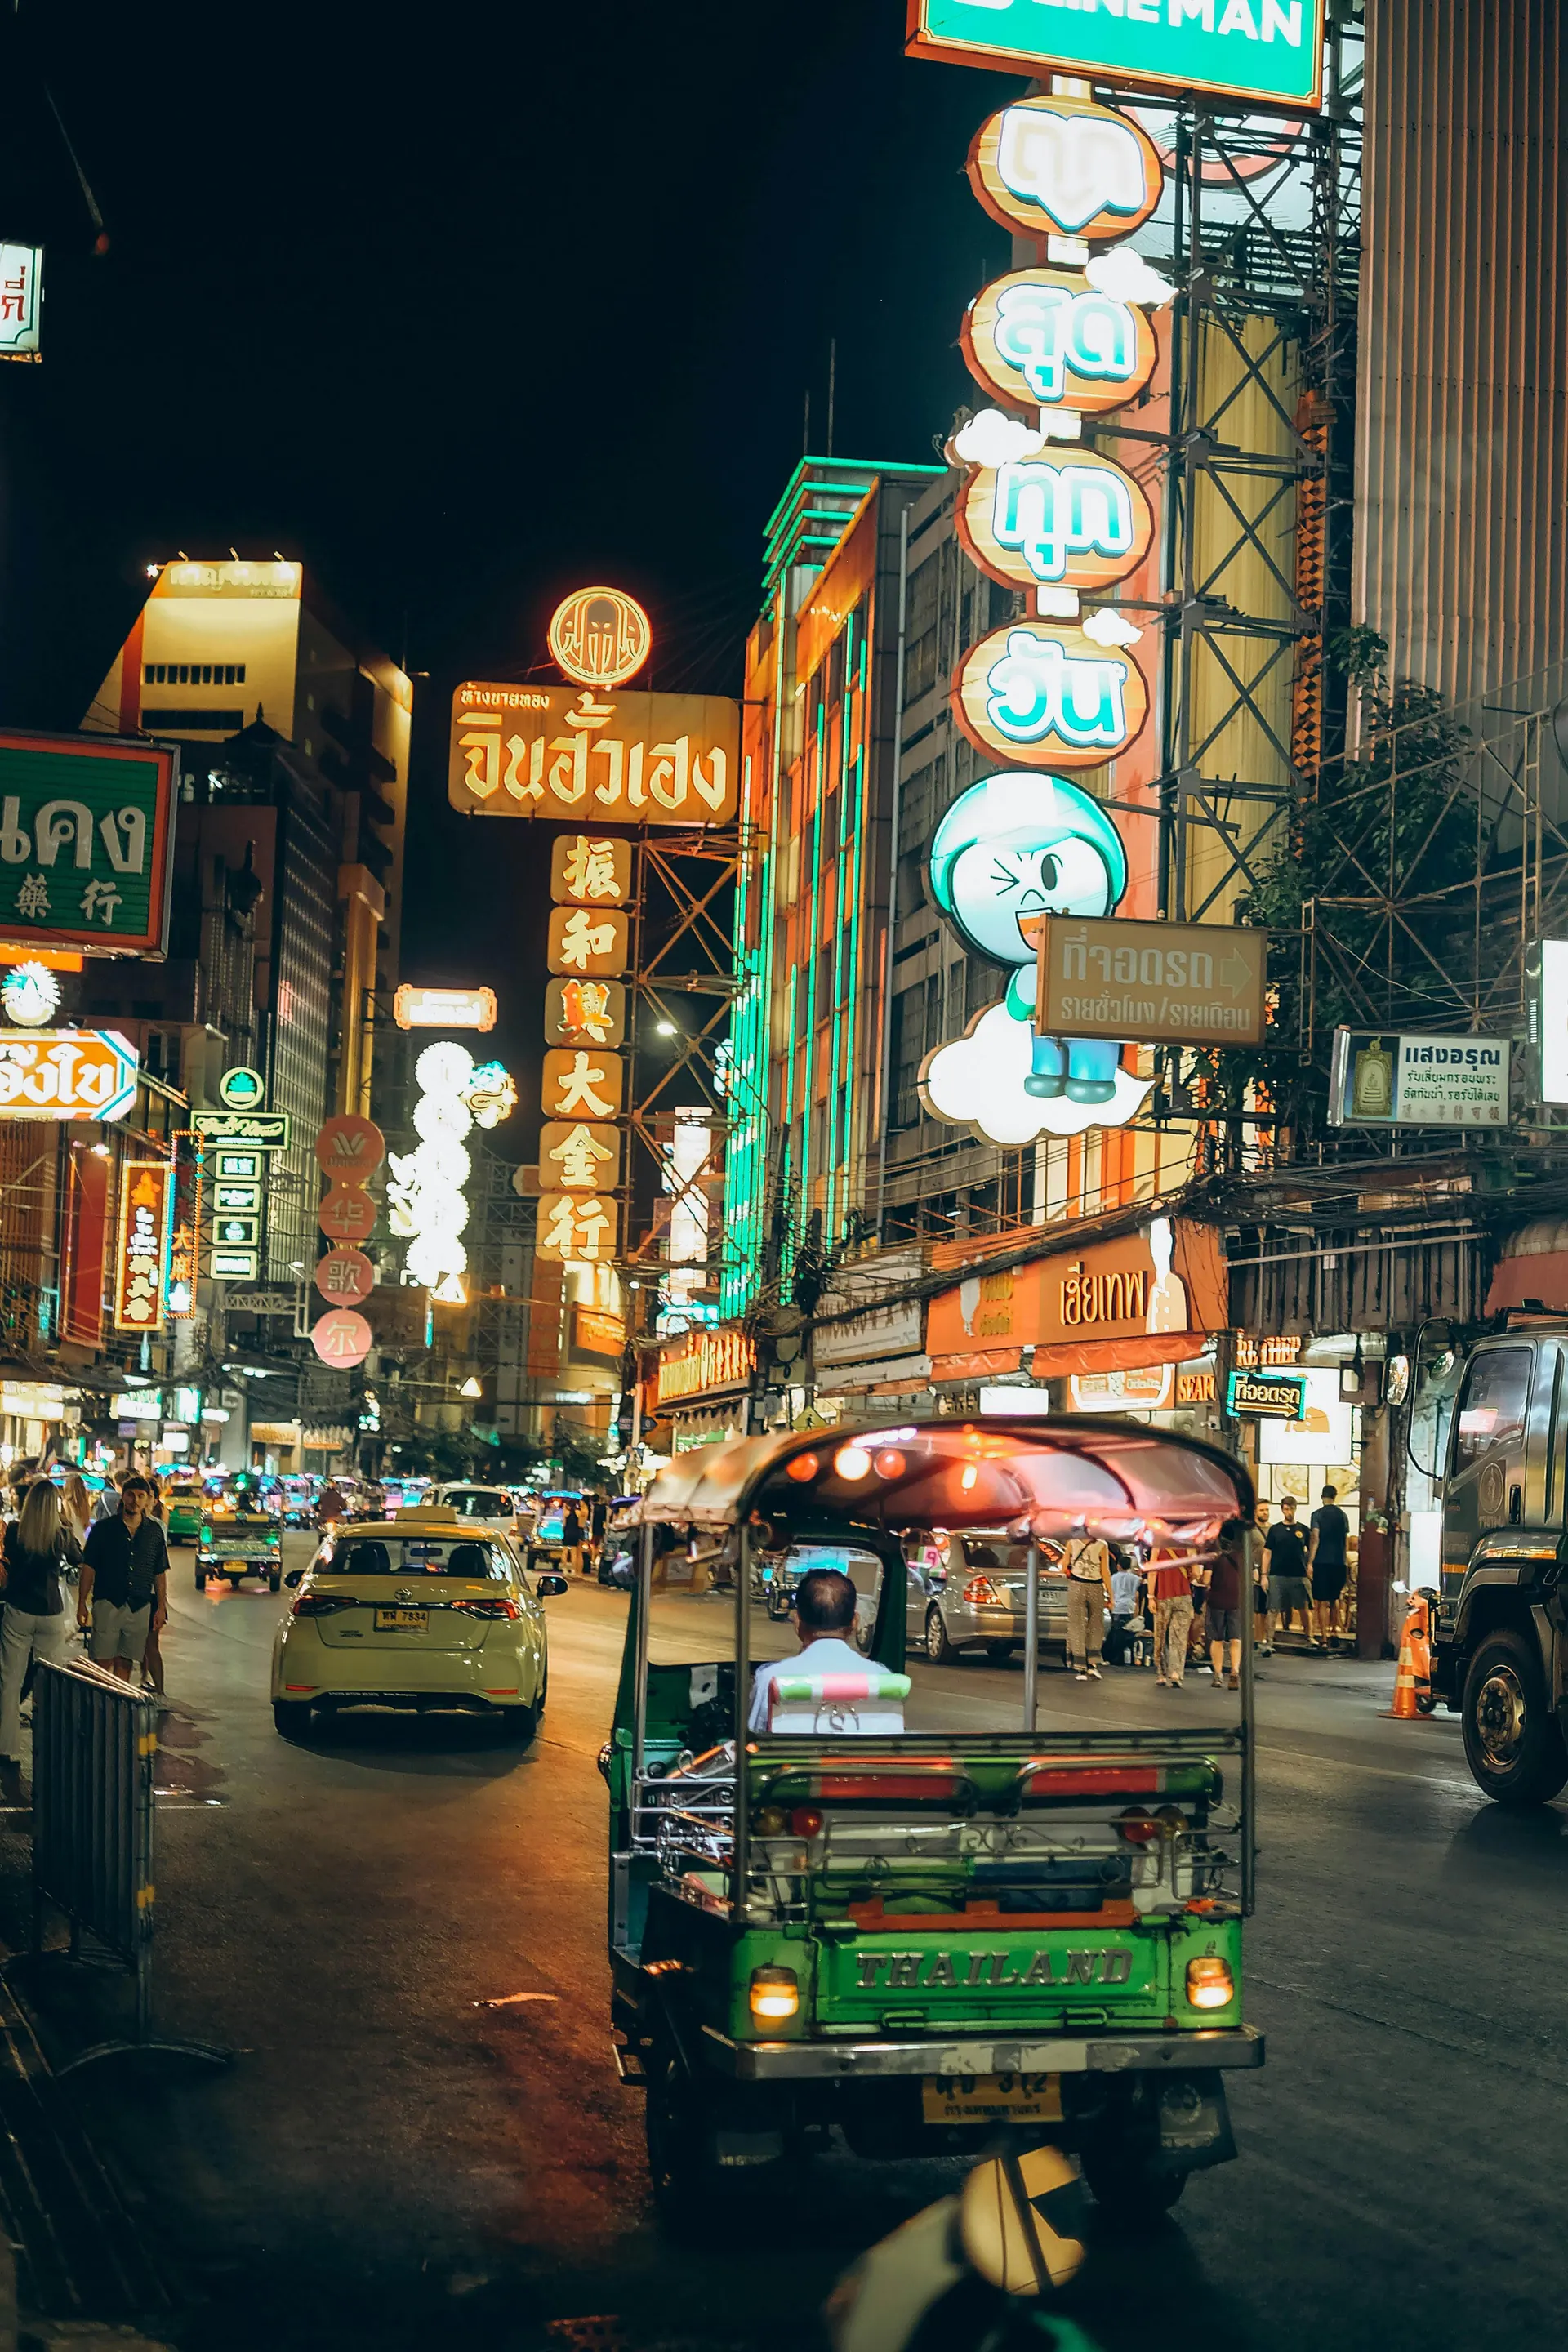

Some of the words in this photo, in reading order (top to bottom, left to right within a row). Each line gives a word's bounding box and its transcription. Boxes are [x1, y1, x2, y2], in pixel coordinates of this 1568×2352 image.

[1003, 292, 1129, 392] สุด
[1003, 469, 1125, 569] ทุก
[460, 682, 550, 710] ห้างขายทอง
[994, 639, 1123, 737] วัน
[456, 690, 728, 812] จินฮั้วเฮง
[1062, 926, 1214, 989] ที่จอดรถ
[1405, 1046, 1501, 1071] แสงอรุณ
[1059, 1261, 1145, 1325] เฮียเทพ
[1236, 1375, 1301, 1404] ที่จอดรถ
[855, 1949, 1134, 1989] THAILAND
